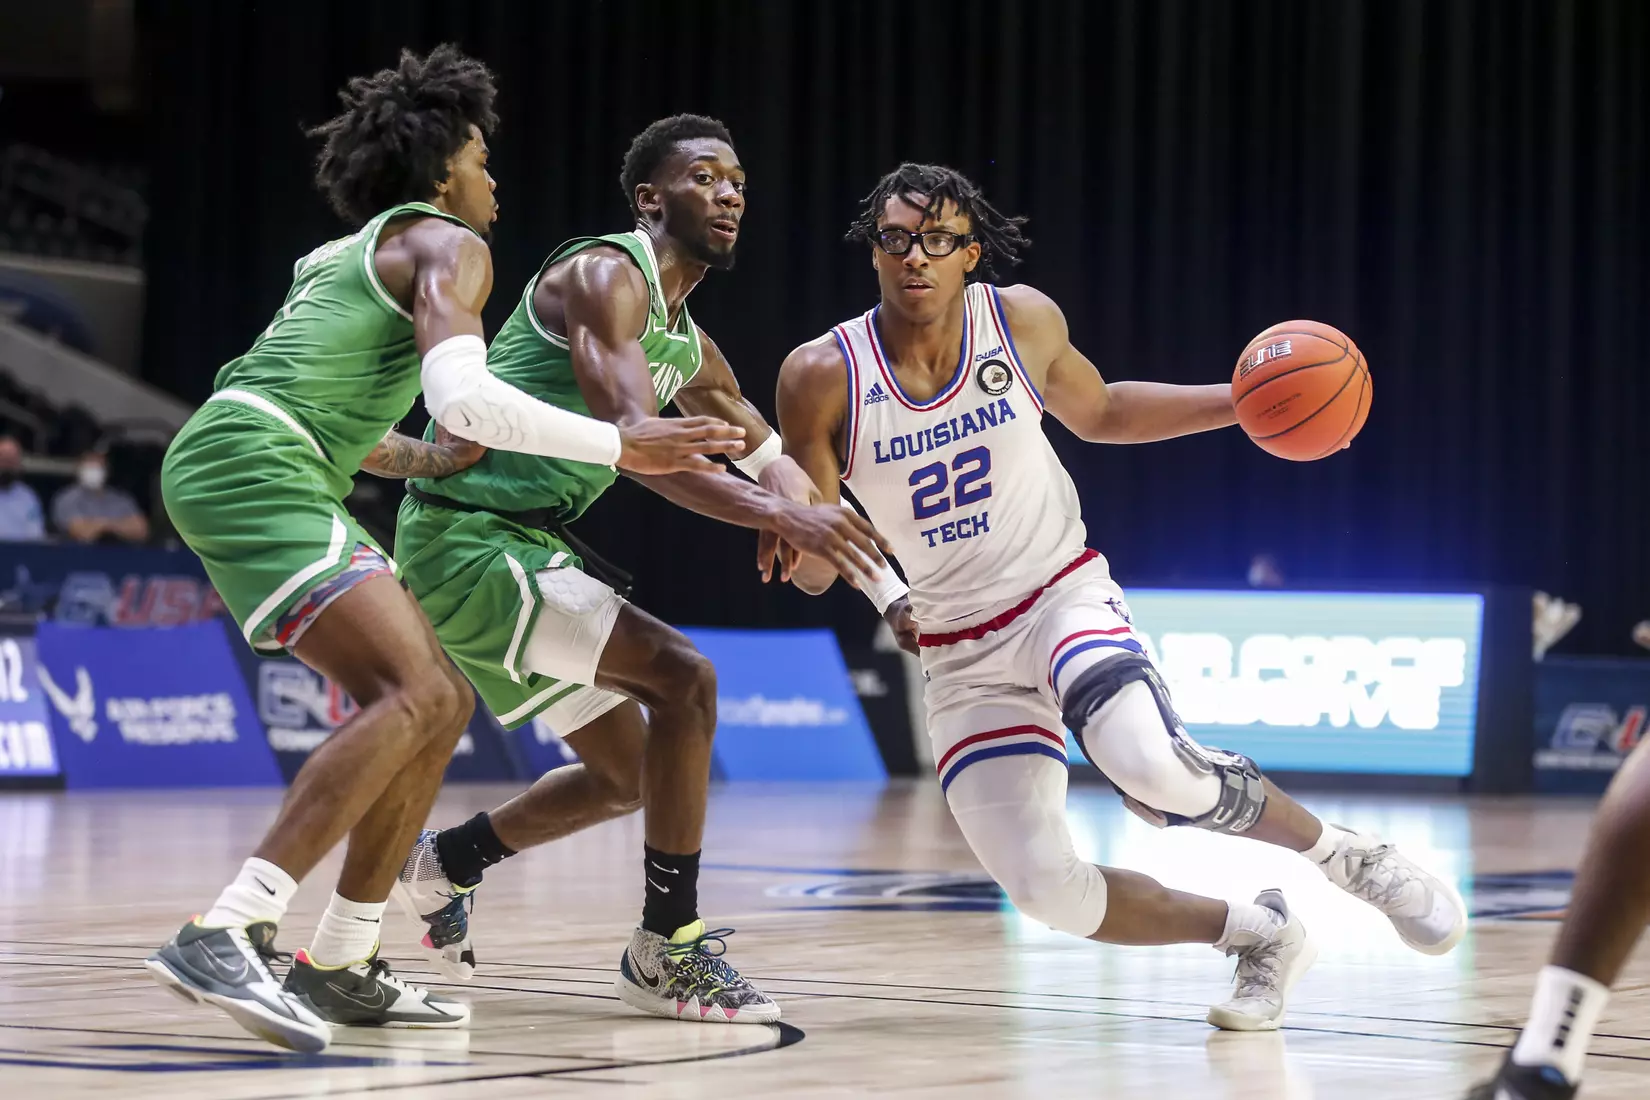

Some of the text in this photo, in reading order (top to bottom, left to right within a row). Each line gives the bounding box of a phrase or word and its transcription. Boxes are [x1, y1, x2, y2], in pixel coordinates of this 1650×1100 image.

[864, 394, 889, 406] adidas
[873, 398, 1016, 464] LOUISIANA
[908, 445, 992, 520] 22
[921, 511, 990, 548] TECH
